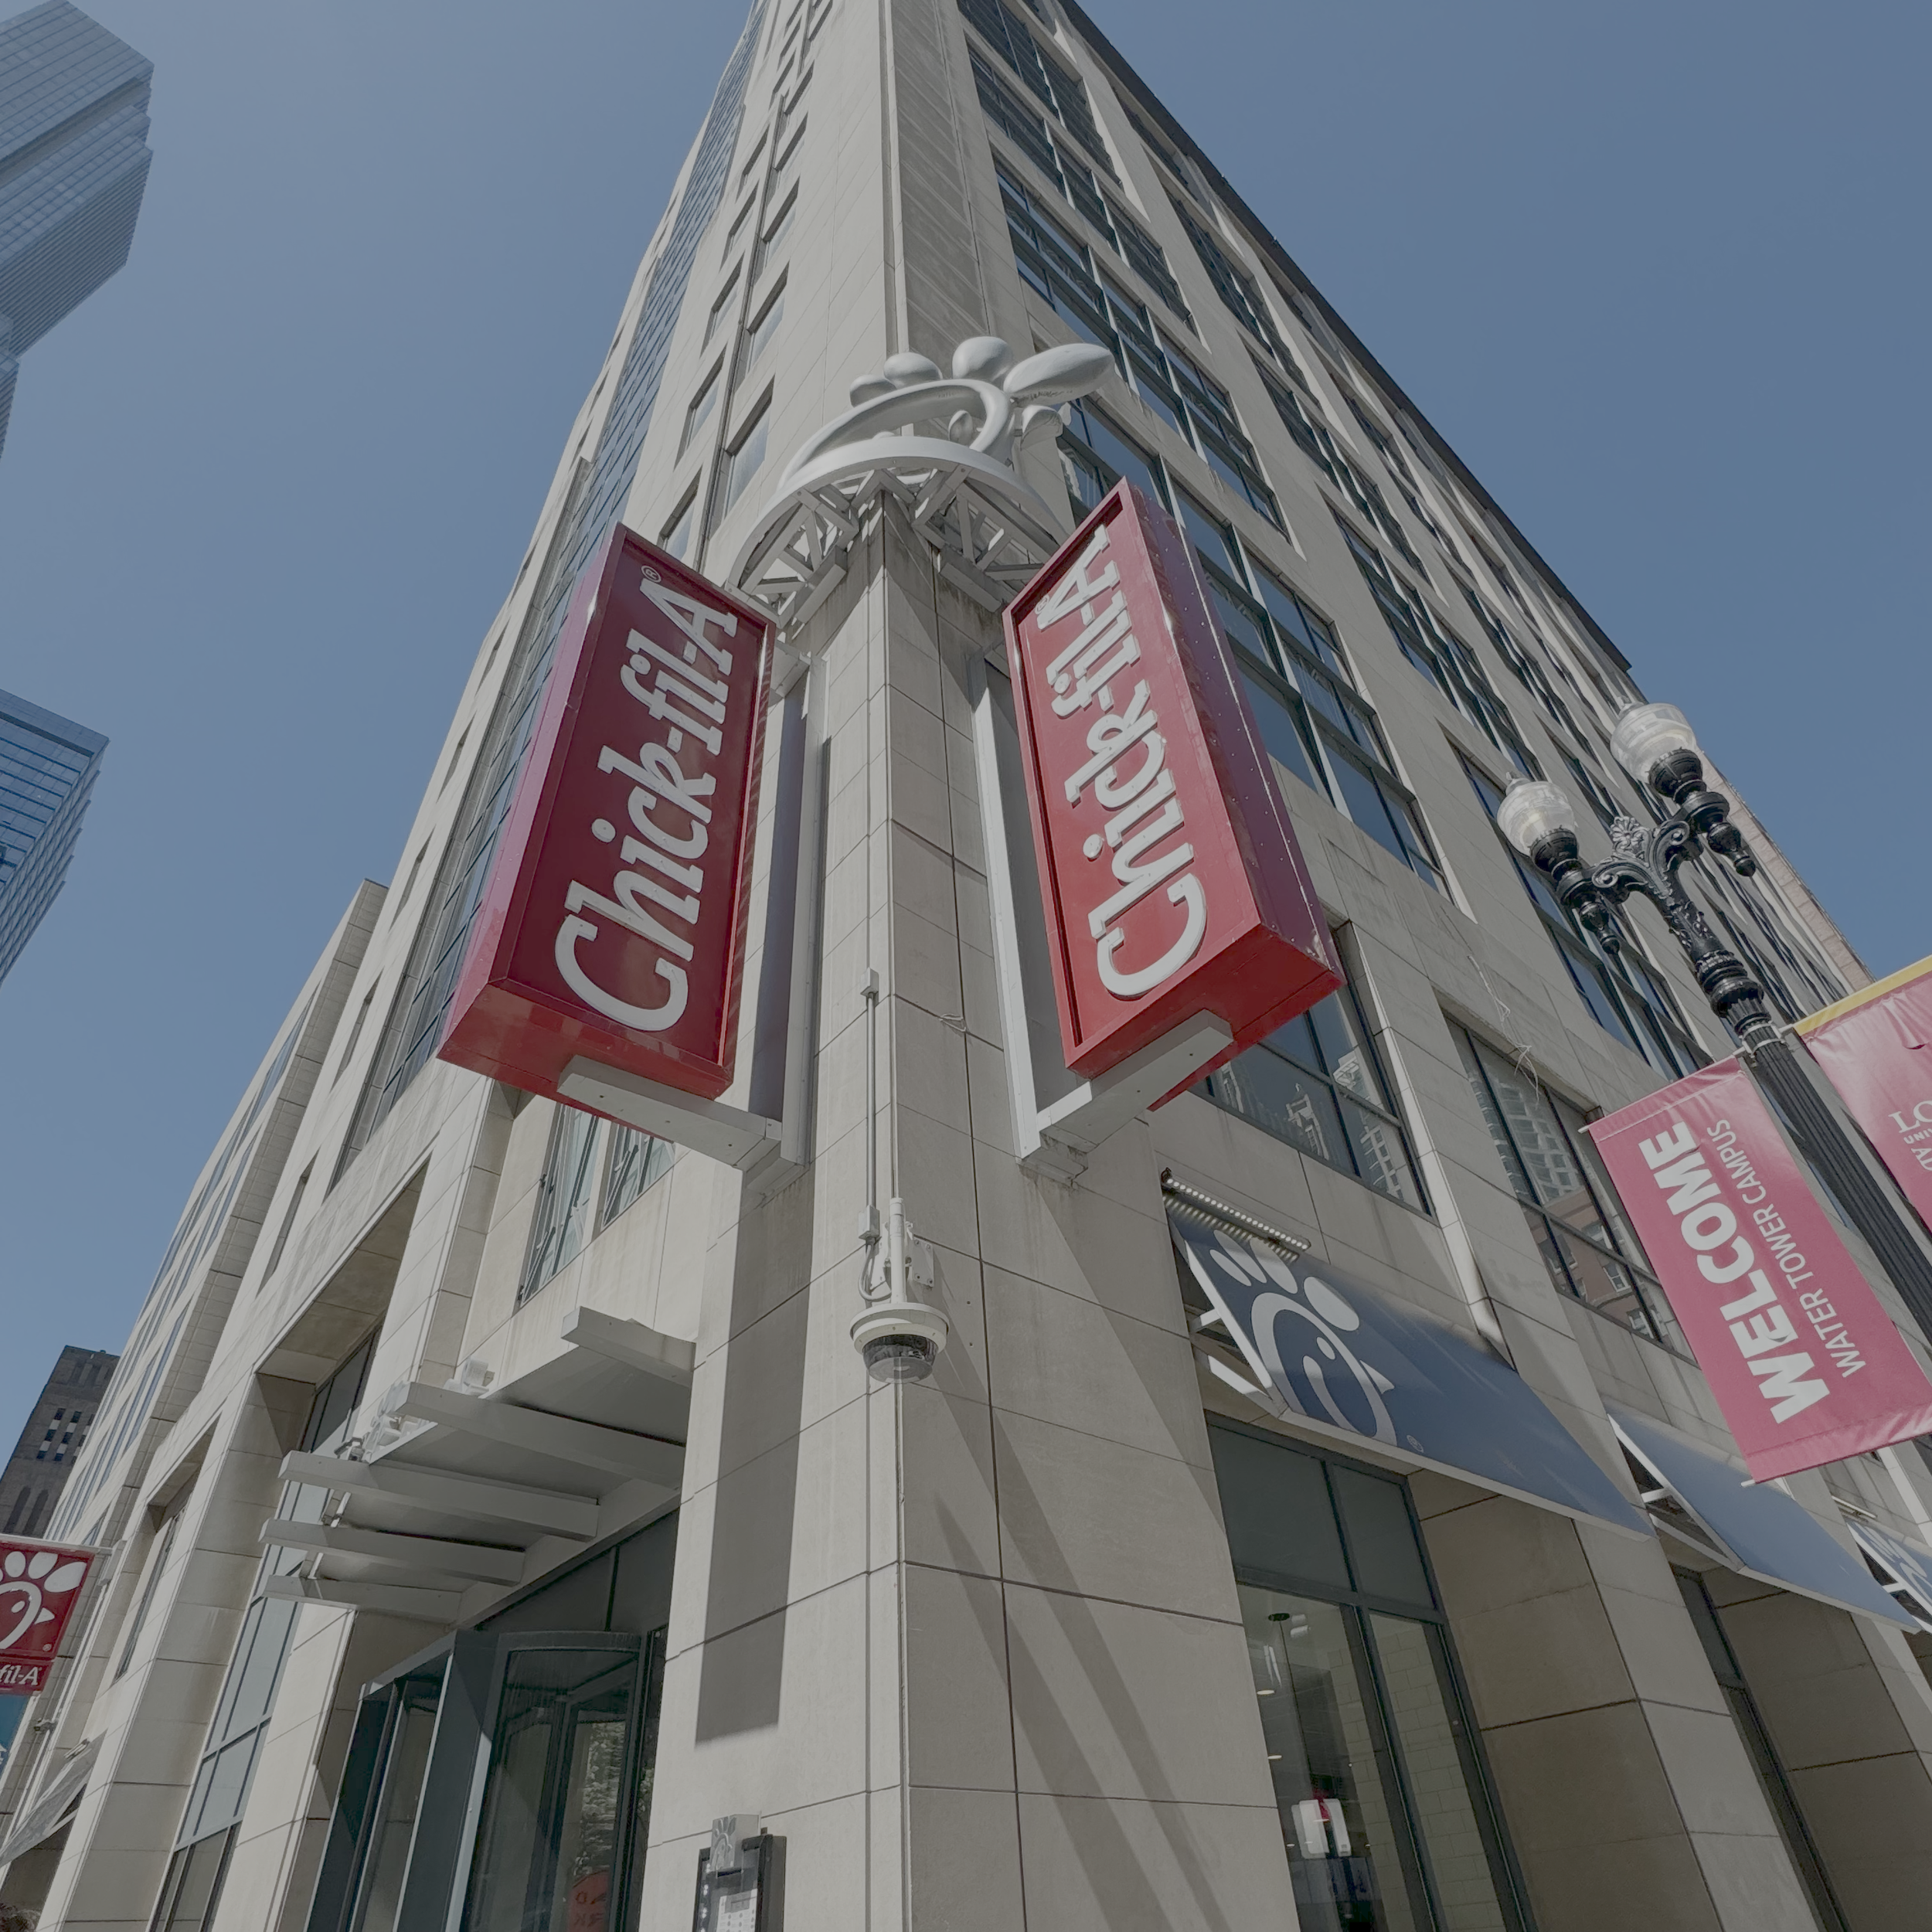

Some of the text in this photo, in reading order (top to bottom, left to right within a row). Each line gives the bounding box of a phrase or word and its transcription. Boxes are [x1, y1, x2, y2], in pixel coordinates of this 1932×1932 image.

[1638, 1121, 1831, 1424] WELCOME
[1706, 1118, 1867, 1379] WATER TOWER CAMPUS
